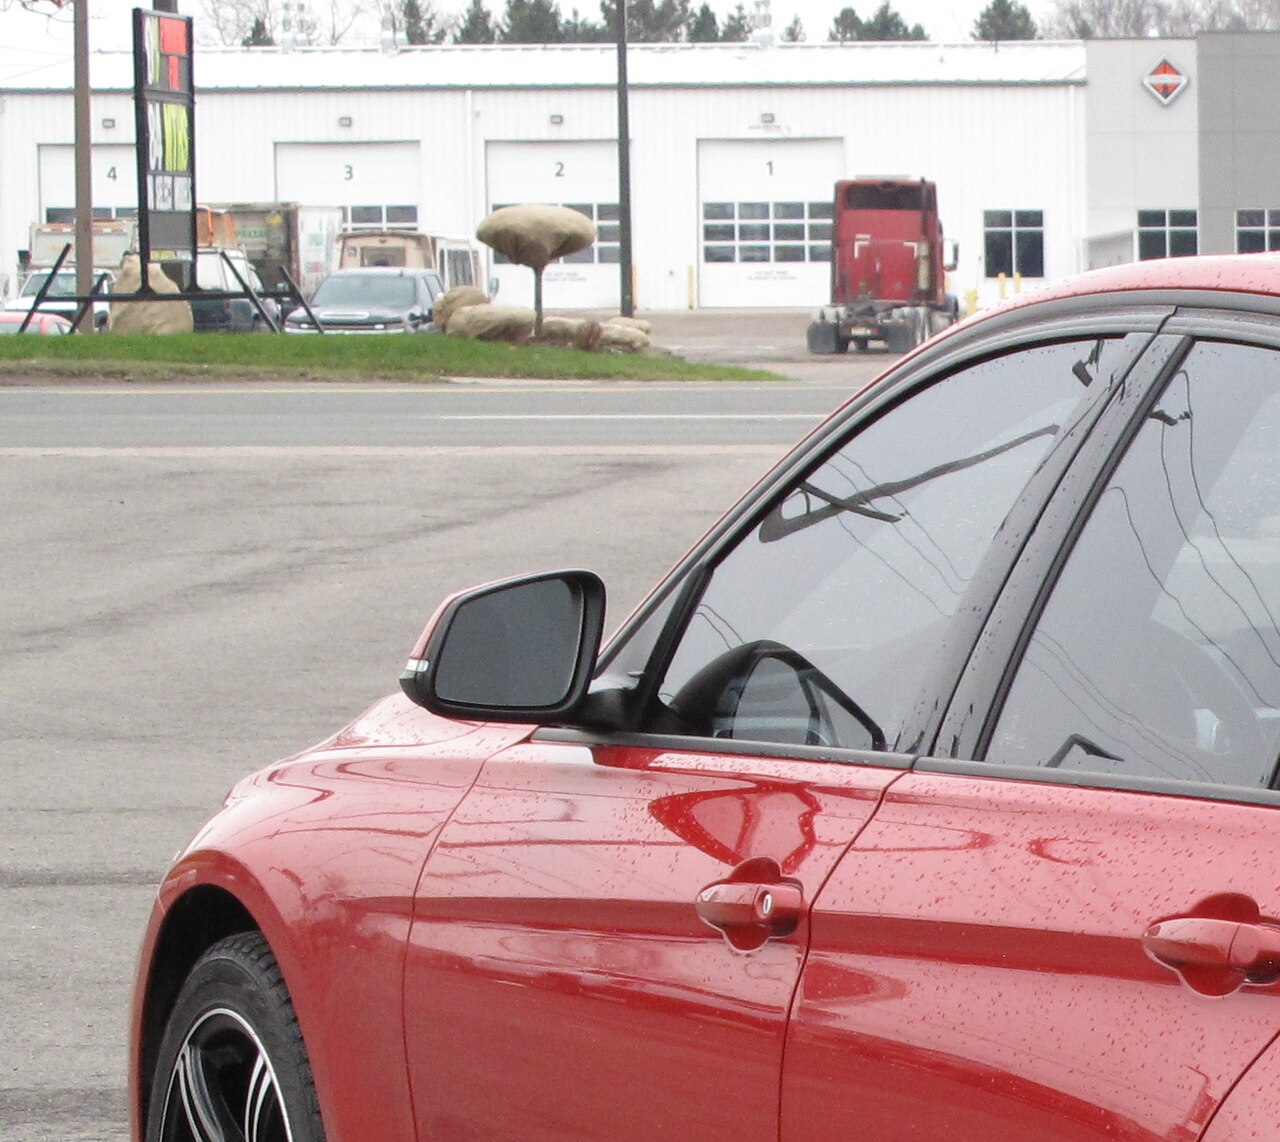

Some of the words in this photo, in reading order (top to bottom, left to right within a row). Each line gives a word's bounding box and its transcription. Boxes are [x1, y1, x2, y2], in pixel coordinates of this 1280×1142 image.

[107, 165, 118, 182] 4
[343, 164, 354, 181] 3
[554, 161, 565, 178] 2
[765, 160, 774, 176] 1
